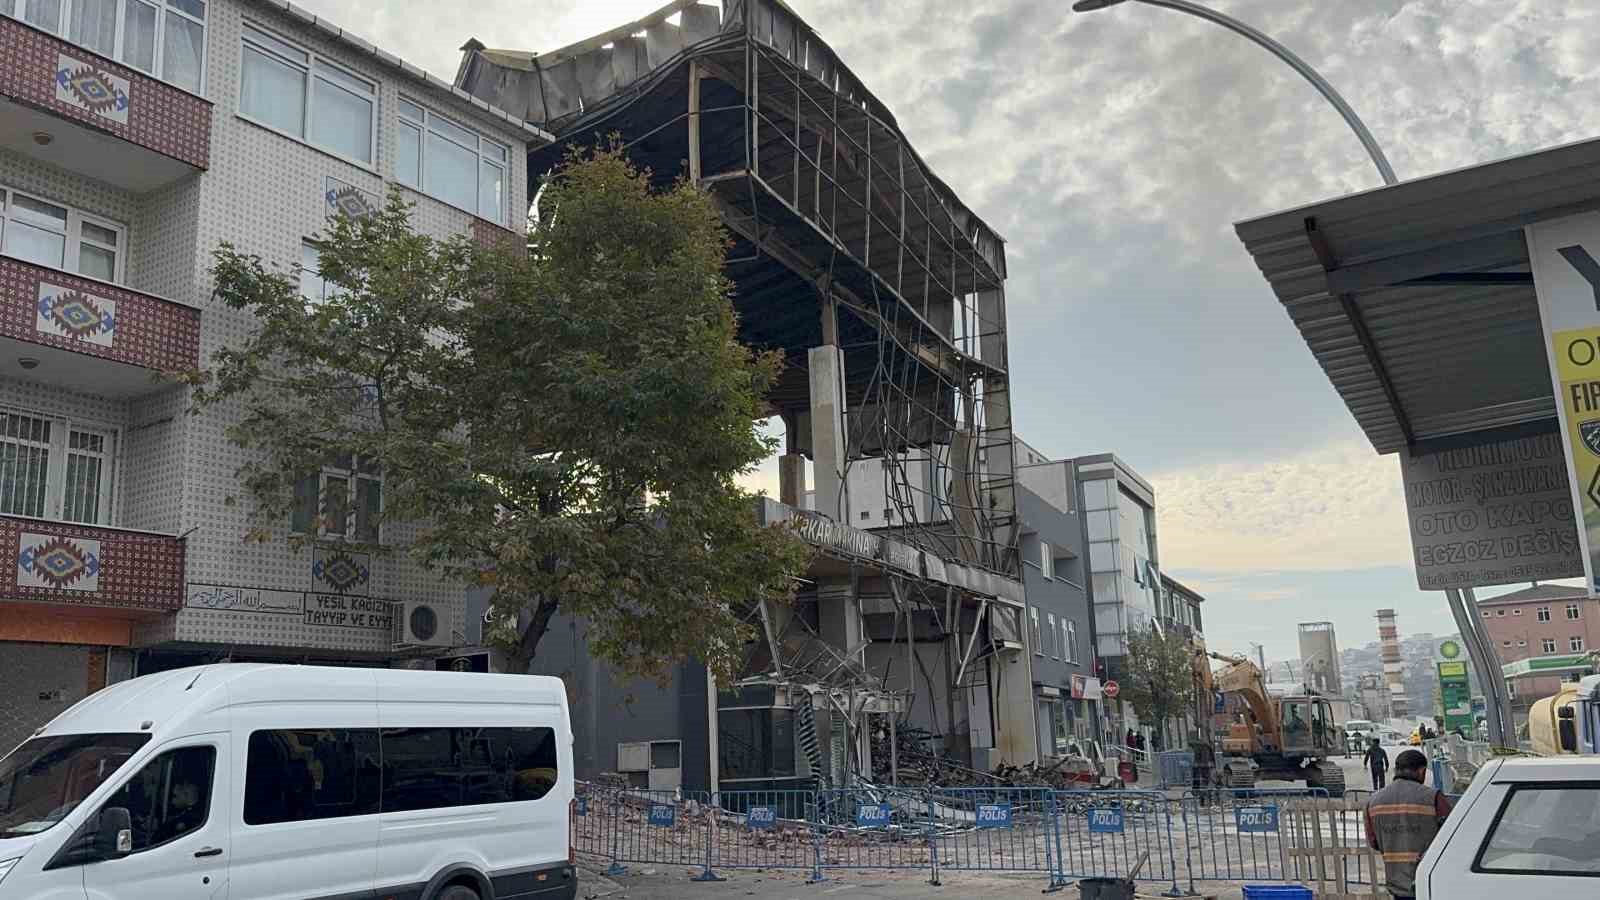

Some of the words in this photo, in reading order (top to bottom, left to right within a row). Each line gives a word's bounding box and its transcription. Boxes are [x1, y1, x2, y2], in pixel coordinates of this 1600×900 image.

[1568, 336, 1600, 366] O
[1416, 508, 1480, 536] OTO
[1418, 539, 1498, 566] EGZOZ
[350, 614, 365, 626] VE
